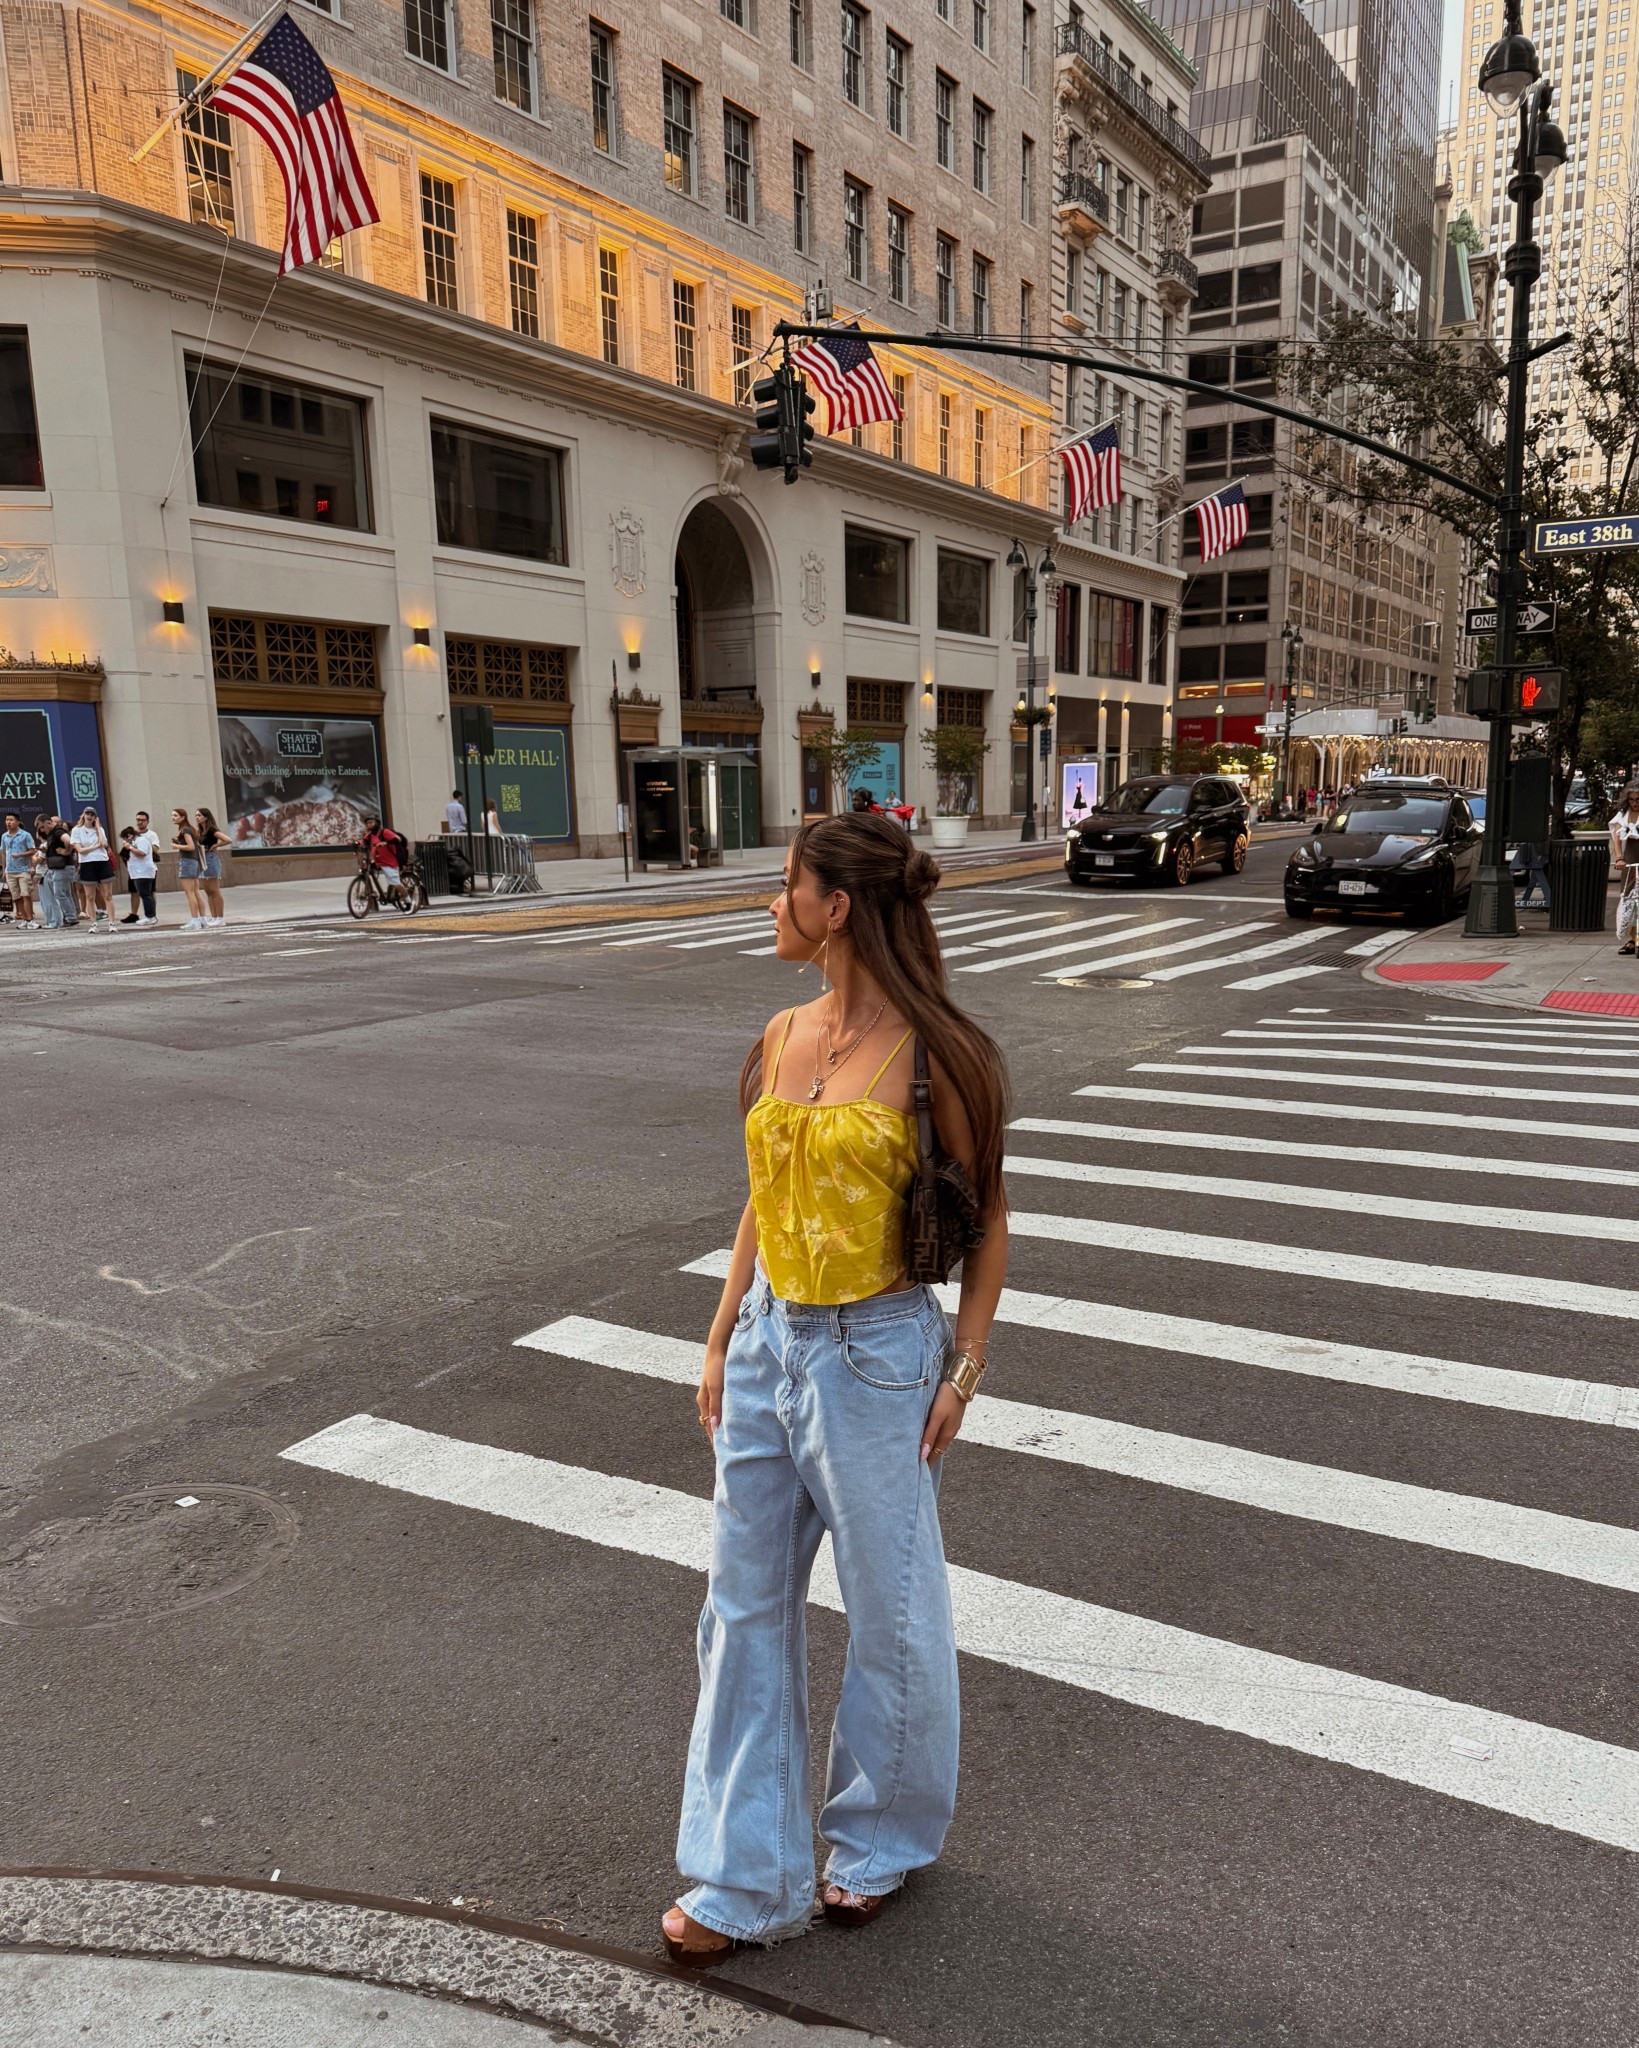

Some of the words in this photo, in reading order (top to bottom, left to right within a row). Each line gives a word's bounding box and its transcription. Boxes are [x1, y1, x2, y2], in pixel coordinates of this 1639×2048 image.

[1544, 528, 1586, 546] East
[1590, 523, 1633, 543] 38th
[1474, 615, 1497, 627] ONE
[281, 733, 318, 744] SHAVER
[225, 764, 252, 775] Iconic
[294, 765, 336, 776] Innovative
[0, 772, 47, 786] AVER
[0, 804, 20, 814] ming
[21, 804, 43, 812] Soon
